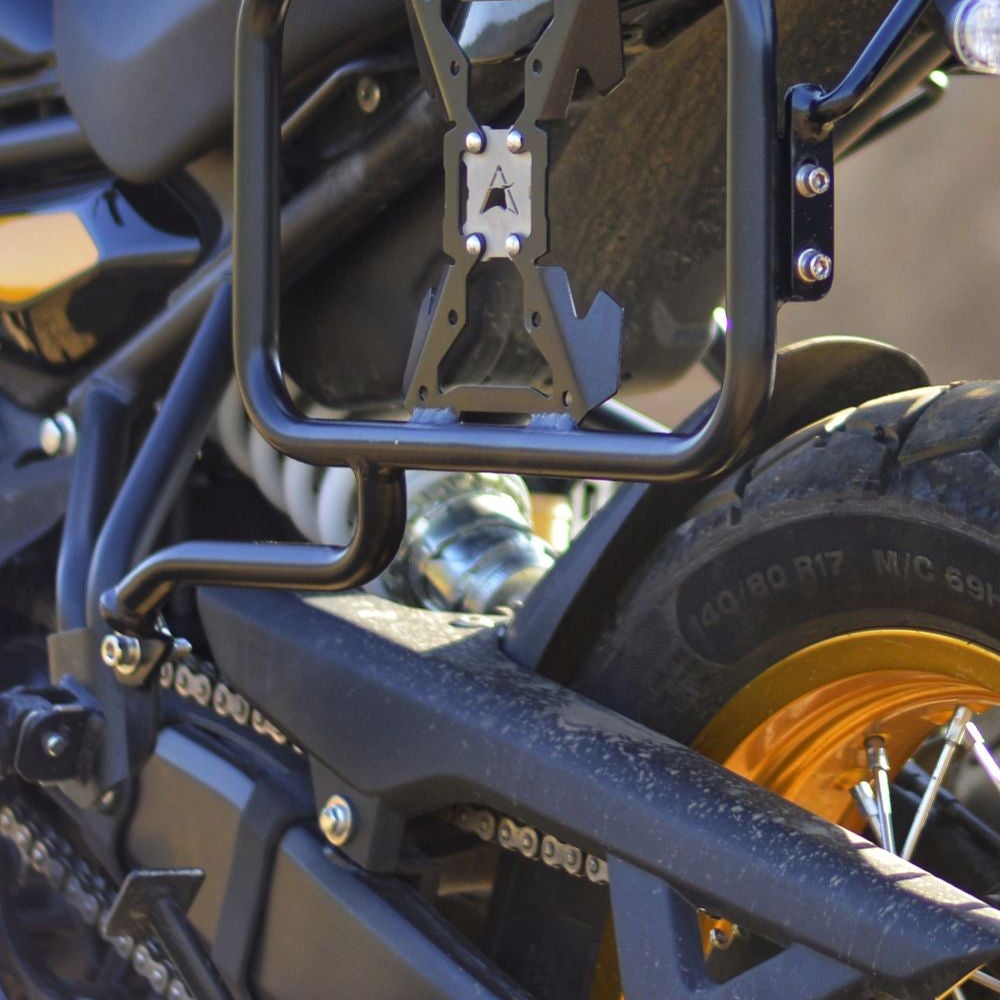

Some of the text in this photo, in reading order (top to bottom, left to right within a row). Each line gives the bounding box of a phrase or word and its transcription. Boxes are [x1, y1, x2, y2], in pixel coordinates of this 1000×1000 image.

[689, 563, 787, 634] 140/80
[793, 550, 844, 582] R17
[872, 548, 935, 582] M/C
